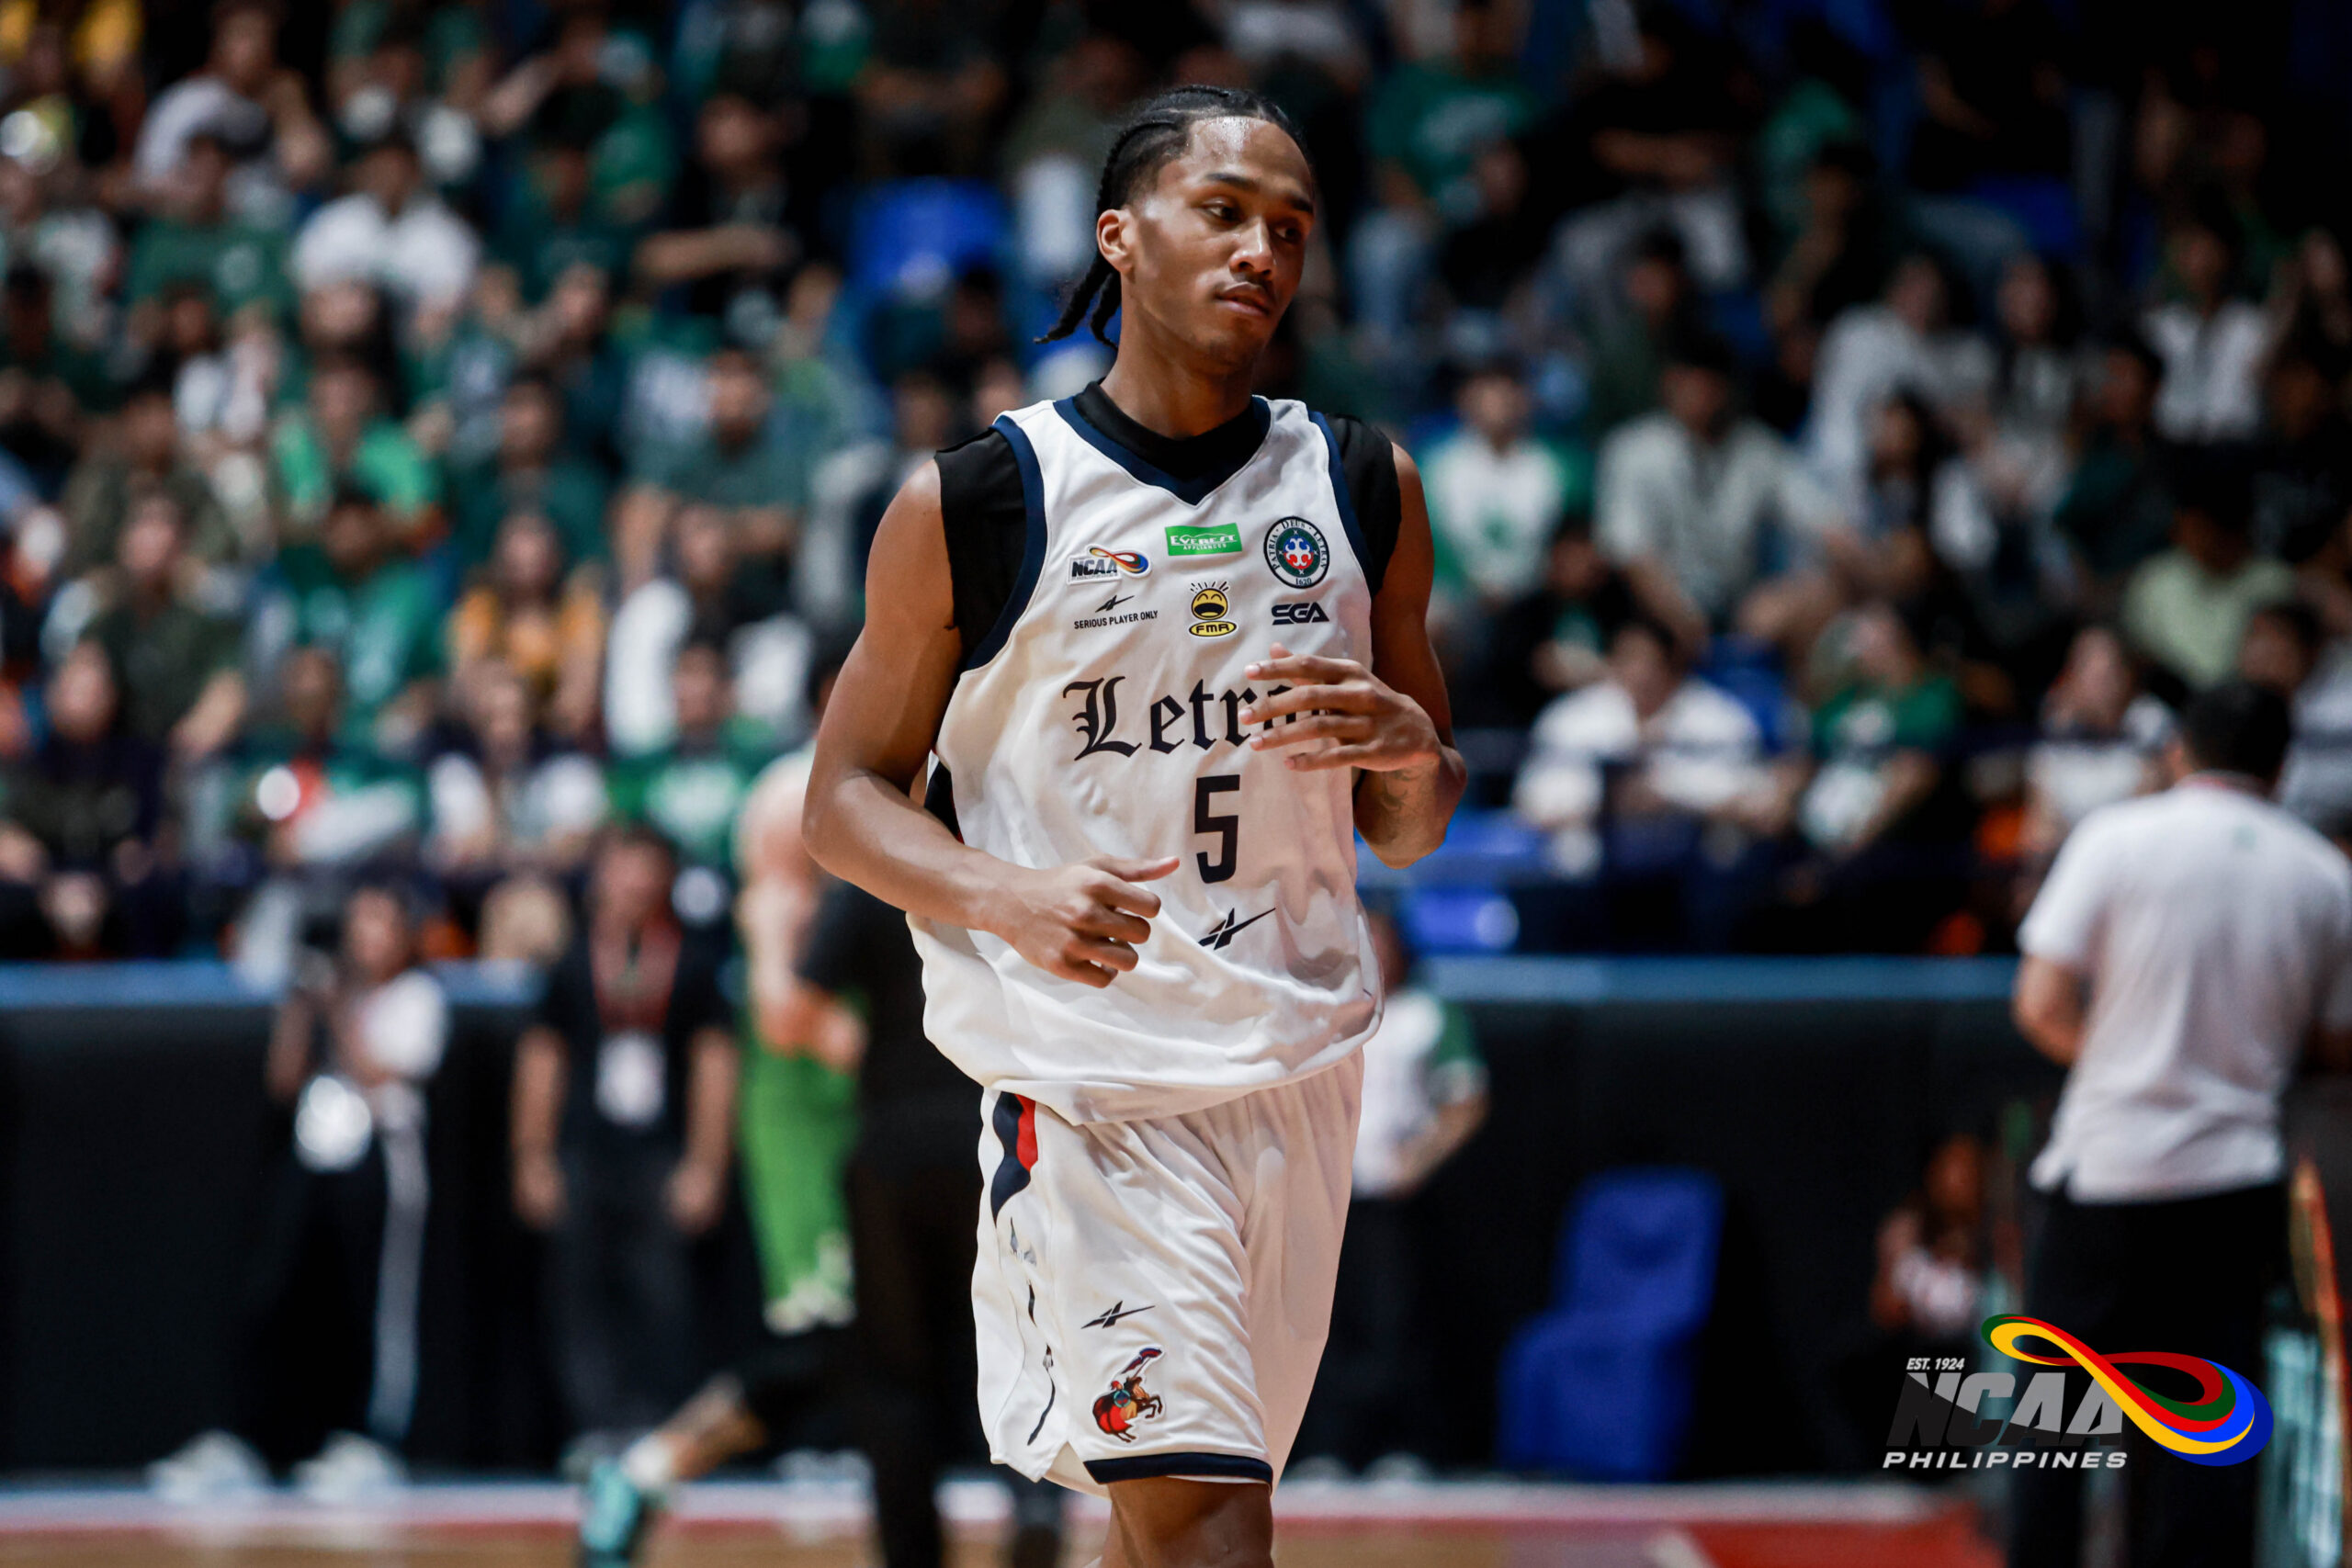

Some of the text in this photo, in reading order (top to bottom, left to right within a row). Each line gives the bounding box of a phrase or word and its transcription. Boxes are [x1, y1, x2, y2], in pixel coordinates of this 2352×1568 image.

[1280, 519, 1306, 530] DEUS
[1071, 558, 1118, 578] NCAA
[1073, 610, 1158, 630] SERIOUS PLAYER ONLY
[1271, 602, 1330, 626] SGA
[1063, 676, 1329, 761] Letr
[1194, 774, 1240, 884] 5
